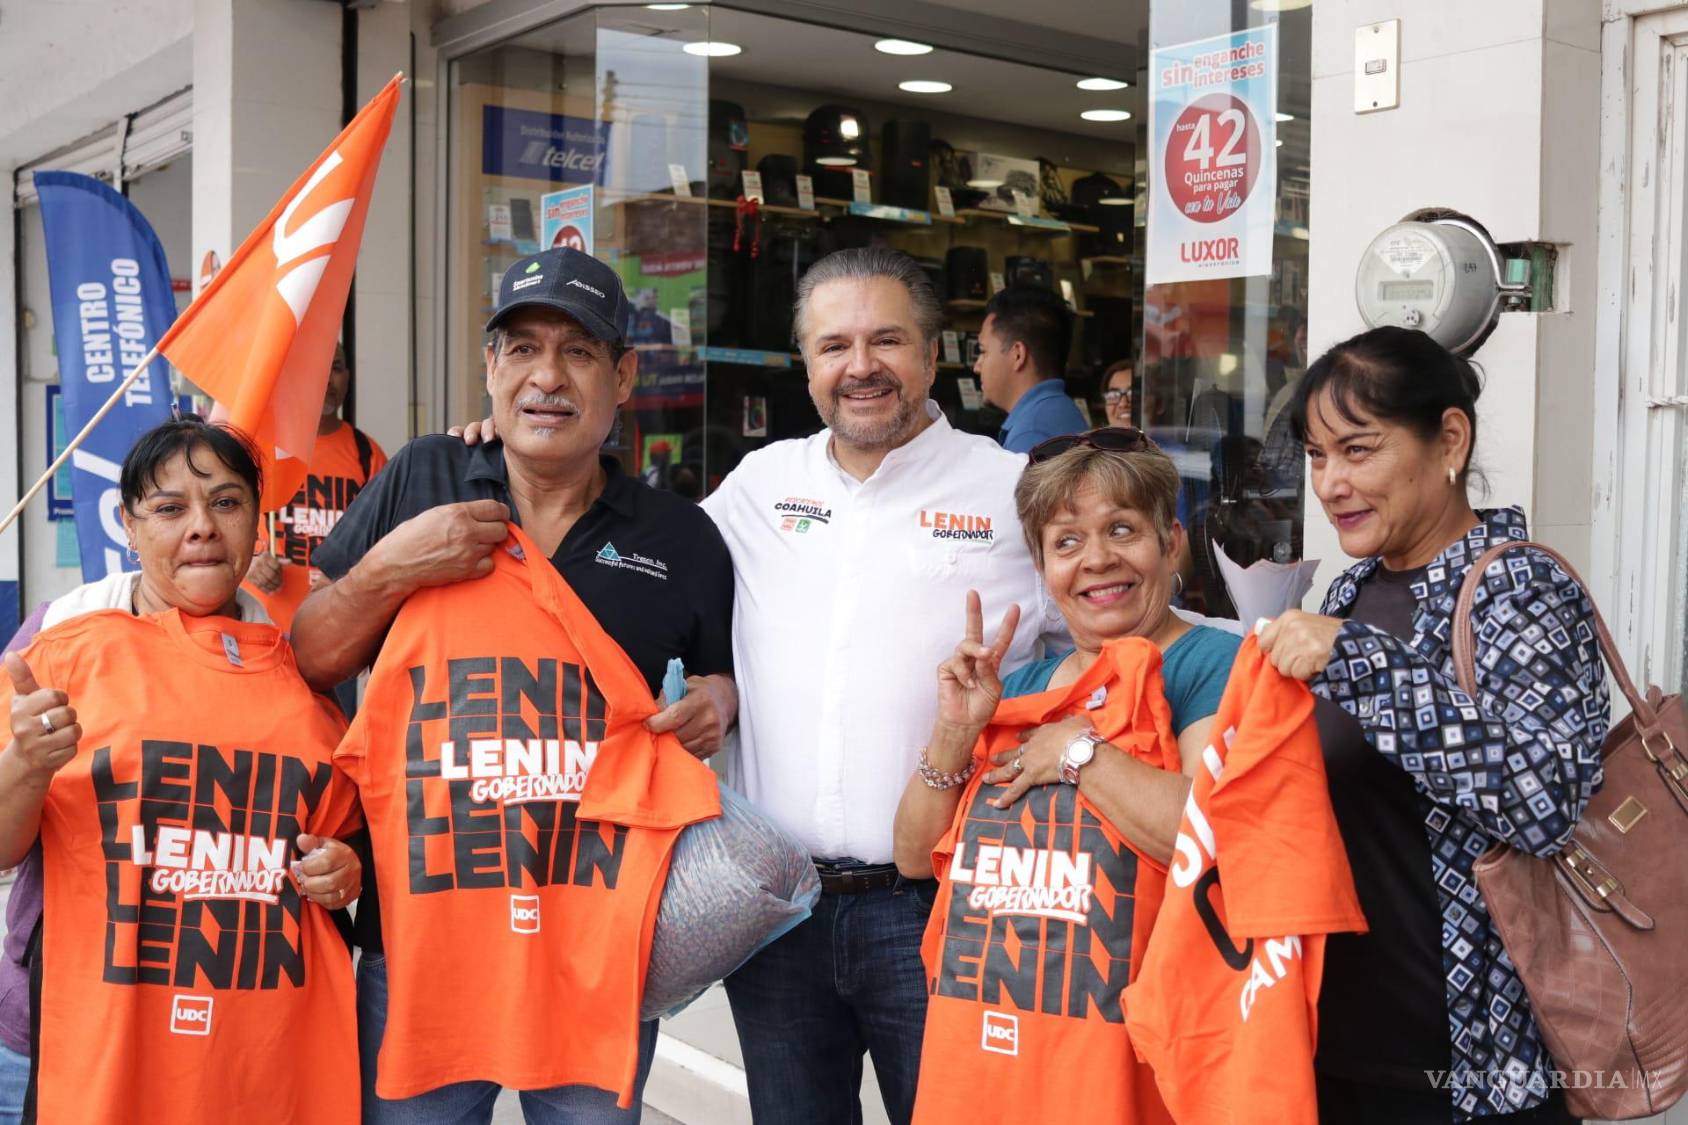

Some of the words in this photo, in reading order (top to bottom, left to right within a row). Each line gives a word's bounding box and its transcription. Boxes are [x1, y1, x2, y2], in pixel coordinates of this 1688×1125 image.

[1162, 63, 1193, 88] sin
[1194, 43, 1265, 69] enganche
[1194, 62, 1265, 88] intereses
[1176, 122, 1196, 133] hasta
[1183, 108, 1247, 170] 42
[1184, 166, 1244, 185] Quincenas
[1193, 182, 1213, 195] para
[1213, 178, 1239, 192] pagar
[1181, 236, 1240, 263] LUXOR
[76, 281, 116, 384] CENTRO
[110, 258, 153, 408] TELEFÓNICO
[774, 502, 832, 518] COAHUILA
[920, 511, 992, 531] LENIN
[933, 528, 994, 541] GOBERNADOR
[91, 740, 332, 815] LENIN
[471, 772, 587, 803] GOBERNADO
[132, 824, 287, 871] LENIN
[409, 824, 628, 894] LENIN
[949, 842, 1091, 889] LENIN
[151, 868, 288, 893] GOBERNADOR
[970, 885, 1094, 913] GOBERNADOR
[512, 906, 538, 921] UDC
[103, 921, 305, 990] LENIN
[176, 1008, 208, 1022] UDC
[986, 1025, 1015, 1041] UDC
